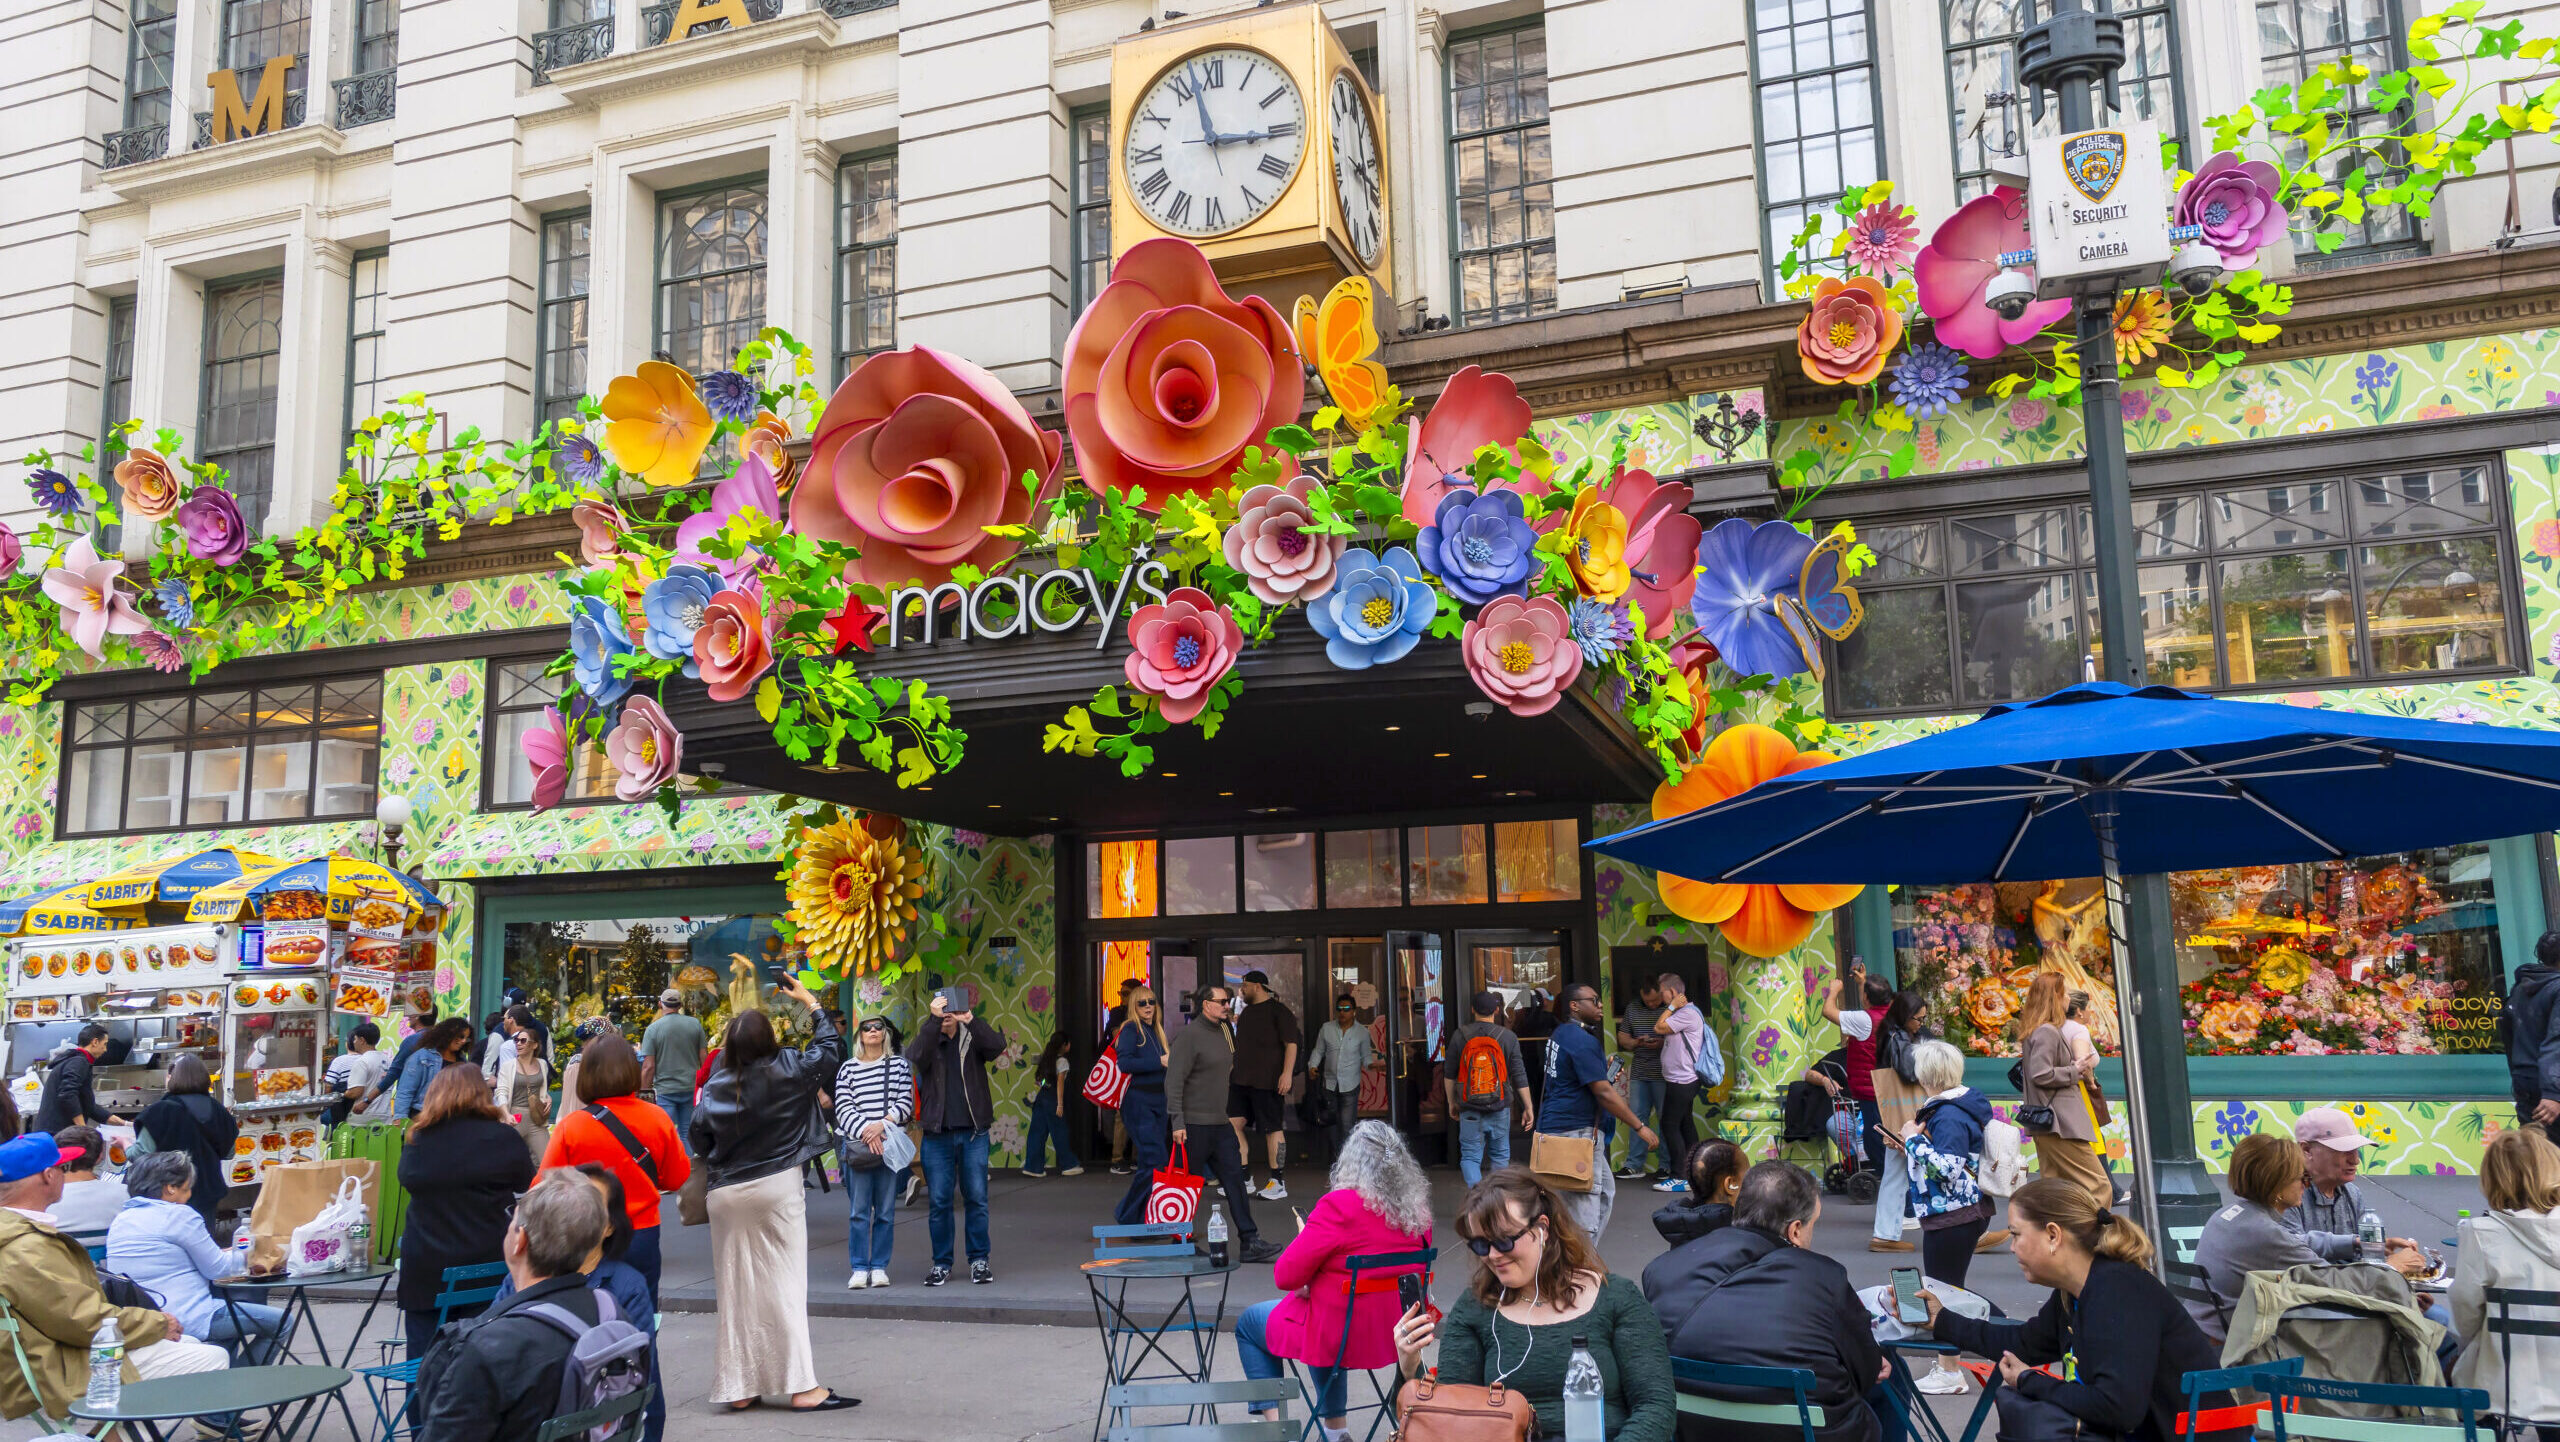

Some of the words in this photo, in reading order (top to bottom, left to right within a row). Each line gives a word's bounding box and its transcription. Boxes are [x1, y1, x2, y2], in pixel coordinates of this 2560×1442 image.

[207, 53, 296, 144] M
[2076, 135, 2111, 146] POLICE
[2065, 142, 2122, 160] DEPARTMENT
[2068, 167, 2081, 183] CITY
[2079, 183, 2090, 192] OF
[2102, 176, 2115, 192] NEW
[2113, 155, 2124, 174] YORK
[2072, 203, 2129, 224] SECURITY
[2169, 224, 2202, 240] NYPD
[2001, 249, 2033, 265] NYPD
[2079, 241, 2129, 260] CAMERA
[335, 873, 389, 882] SABRETT
[93, 882, 152, 901] SABRETT
[191, 900, 242, 916] SABRETT
[32, 913, 137, 931] SABRETT
[355, 927, 378, 936] CHEESE
[378, 931, 396, 939] FRIES
[2432, 1014, 2500, 1031] flower
[2435, 1032, 2492, 1049] show
[2319, 1384, 2360, 1398] Street
